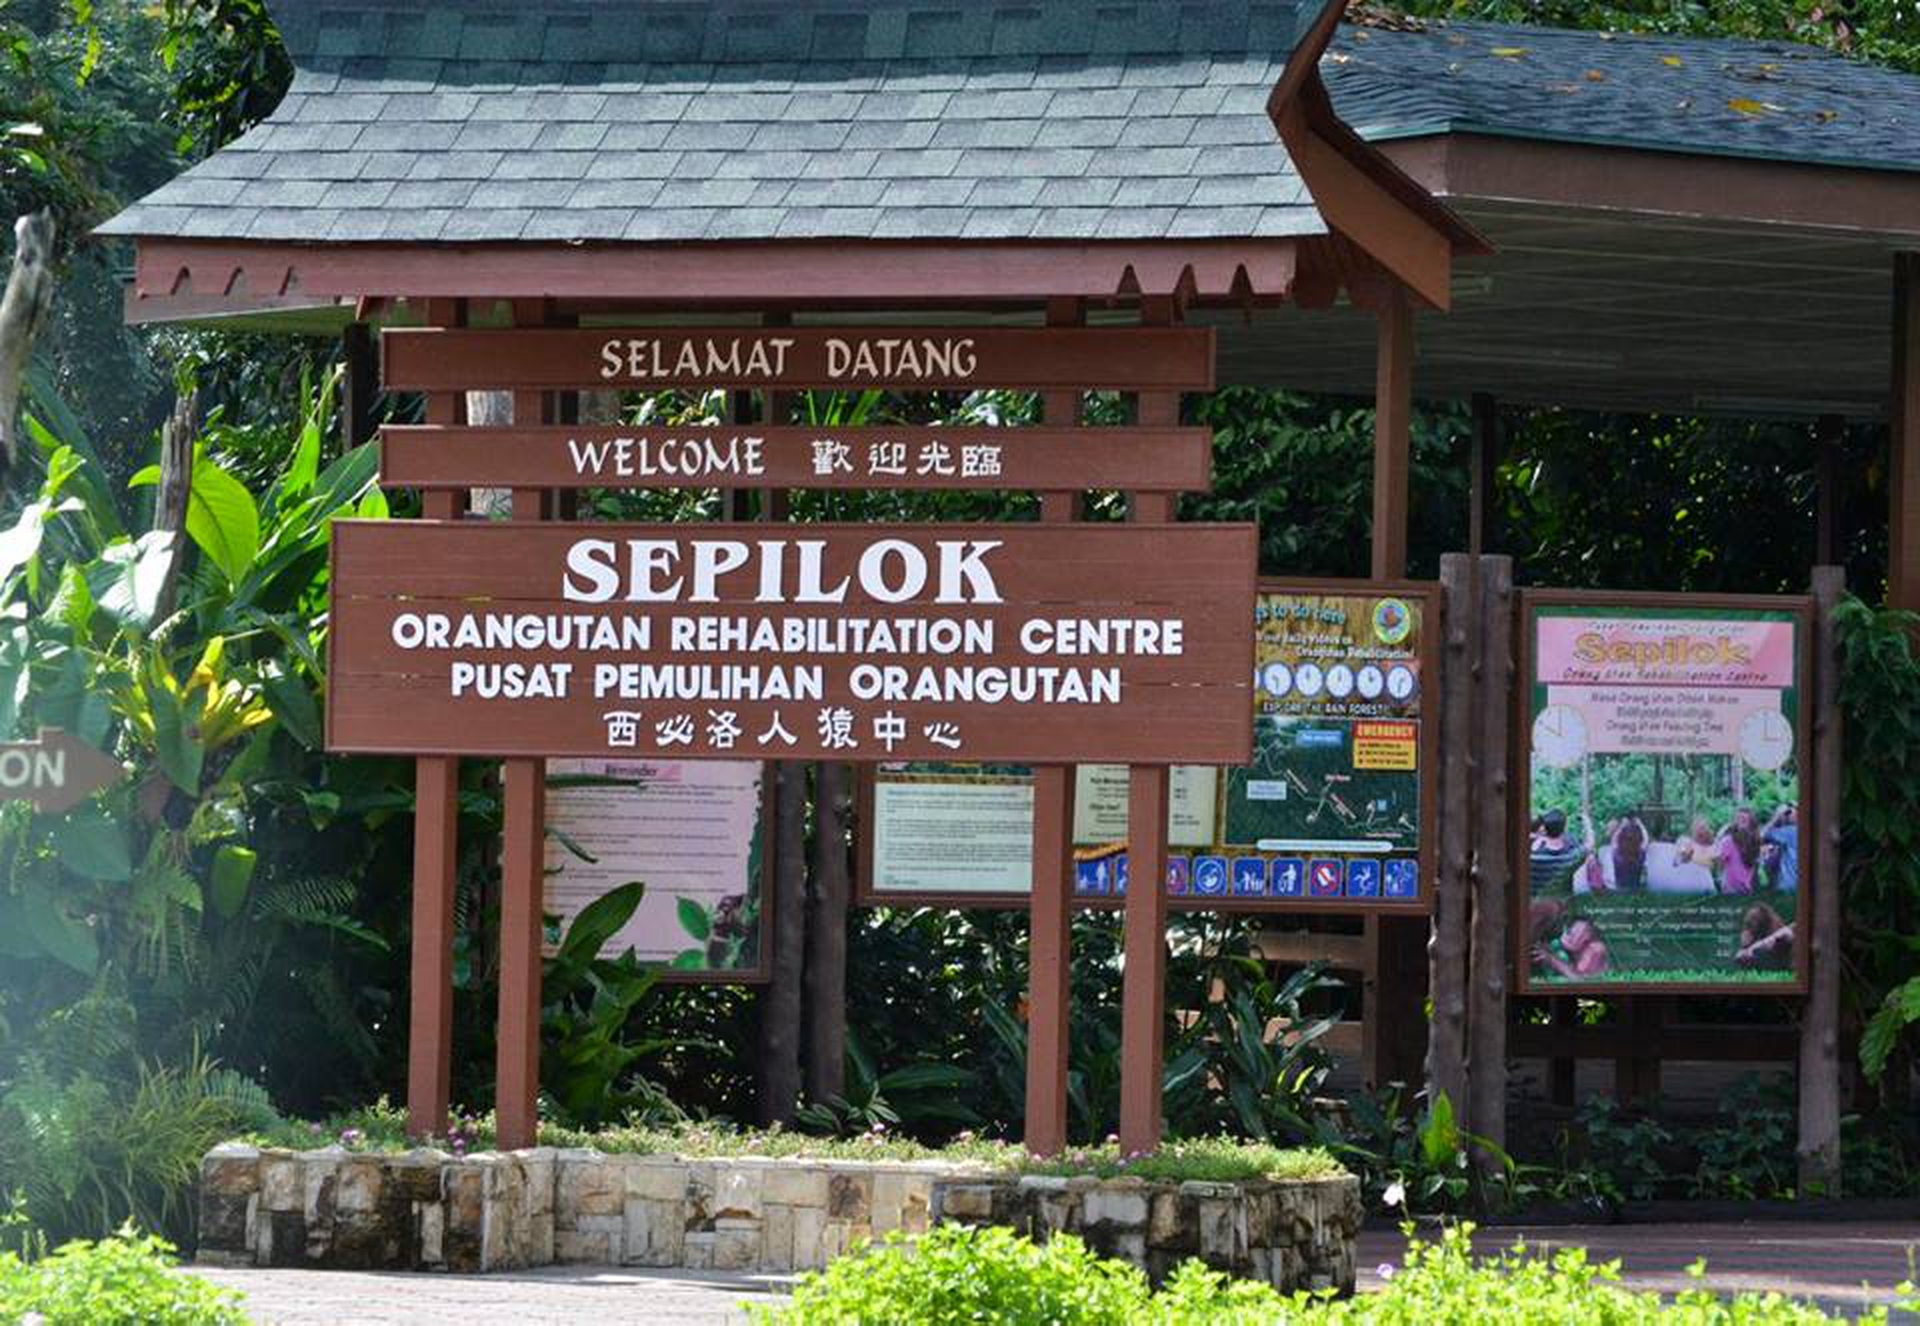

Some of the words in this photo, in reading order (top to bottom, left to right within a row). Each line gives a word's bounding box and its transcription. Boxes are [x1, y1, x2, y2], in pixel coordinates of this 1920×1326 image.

[602, 339, 794, 377] SELAMAT
[825, 340, 977, 377] DATANG
[568, 437, 765, 476] WELCOME
[811, 440, 1002, 478] 歡迎光臨
[562, 538, 1006, 604] SEPILOK
[391, 613, 651, 651] ORANGUTAN
[671, 616, 994, 654] REHABILITATION
[1019, 618, 1184, 656] CENTRE
[1574, 633, 1750, 668] Sepilok
[451, 661, 573, 699] PUSAT
[594, 663, 823, 701] PEMULIHAN
[849, 664, 1121, 704] ORANGUTAN
[602, 706, 962, 752] 西必洛人猿中心
[0, 749, 65, 788] ON
